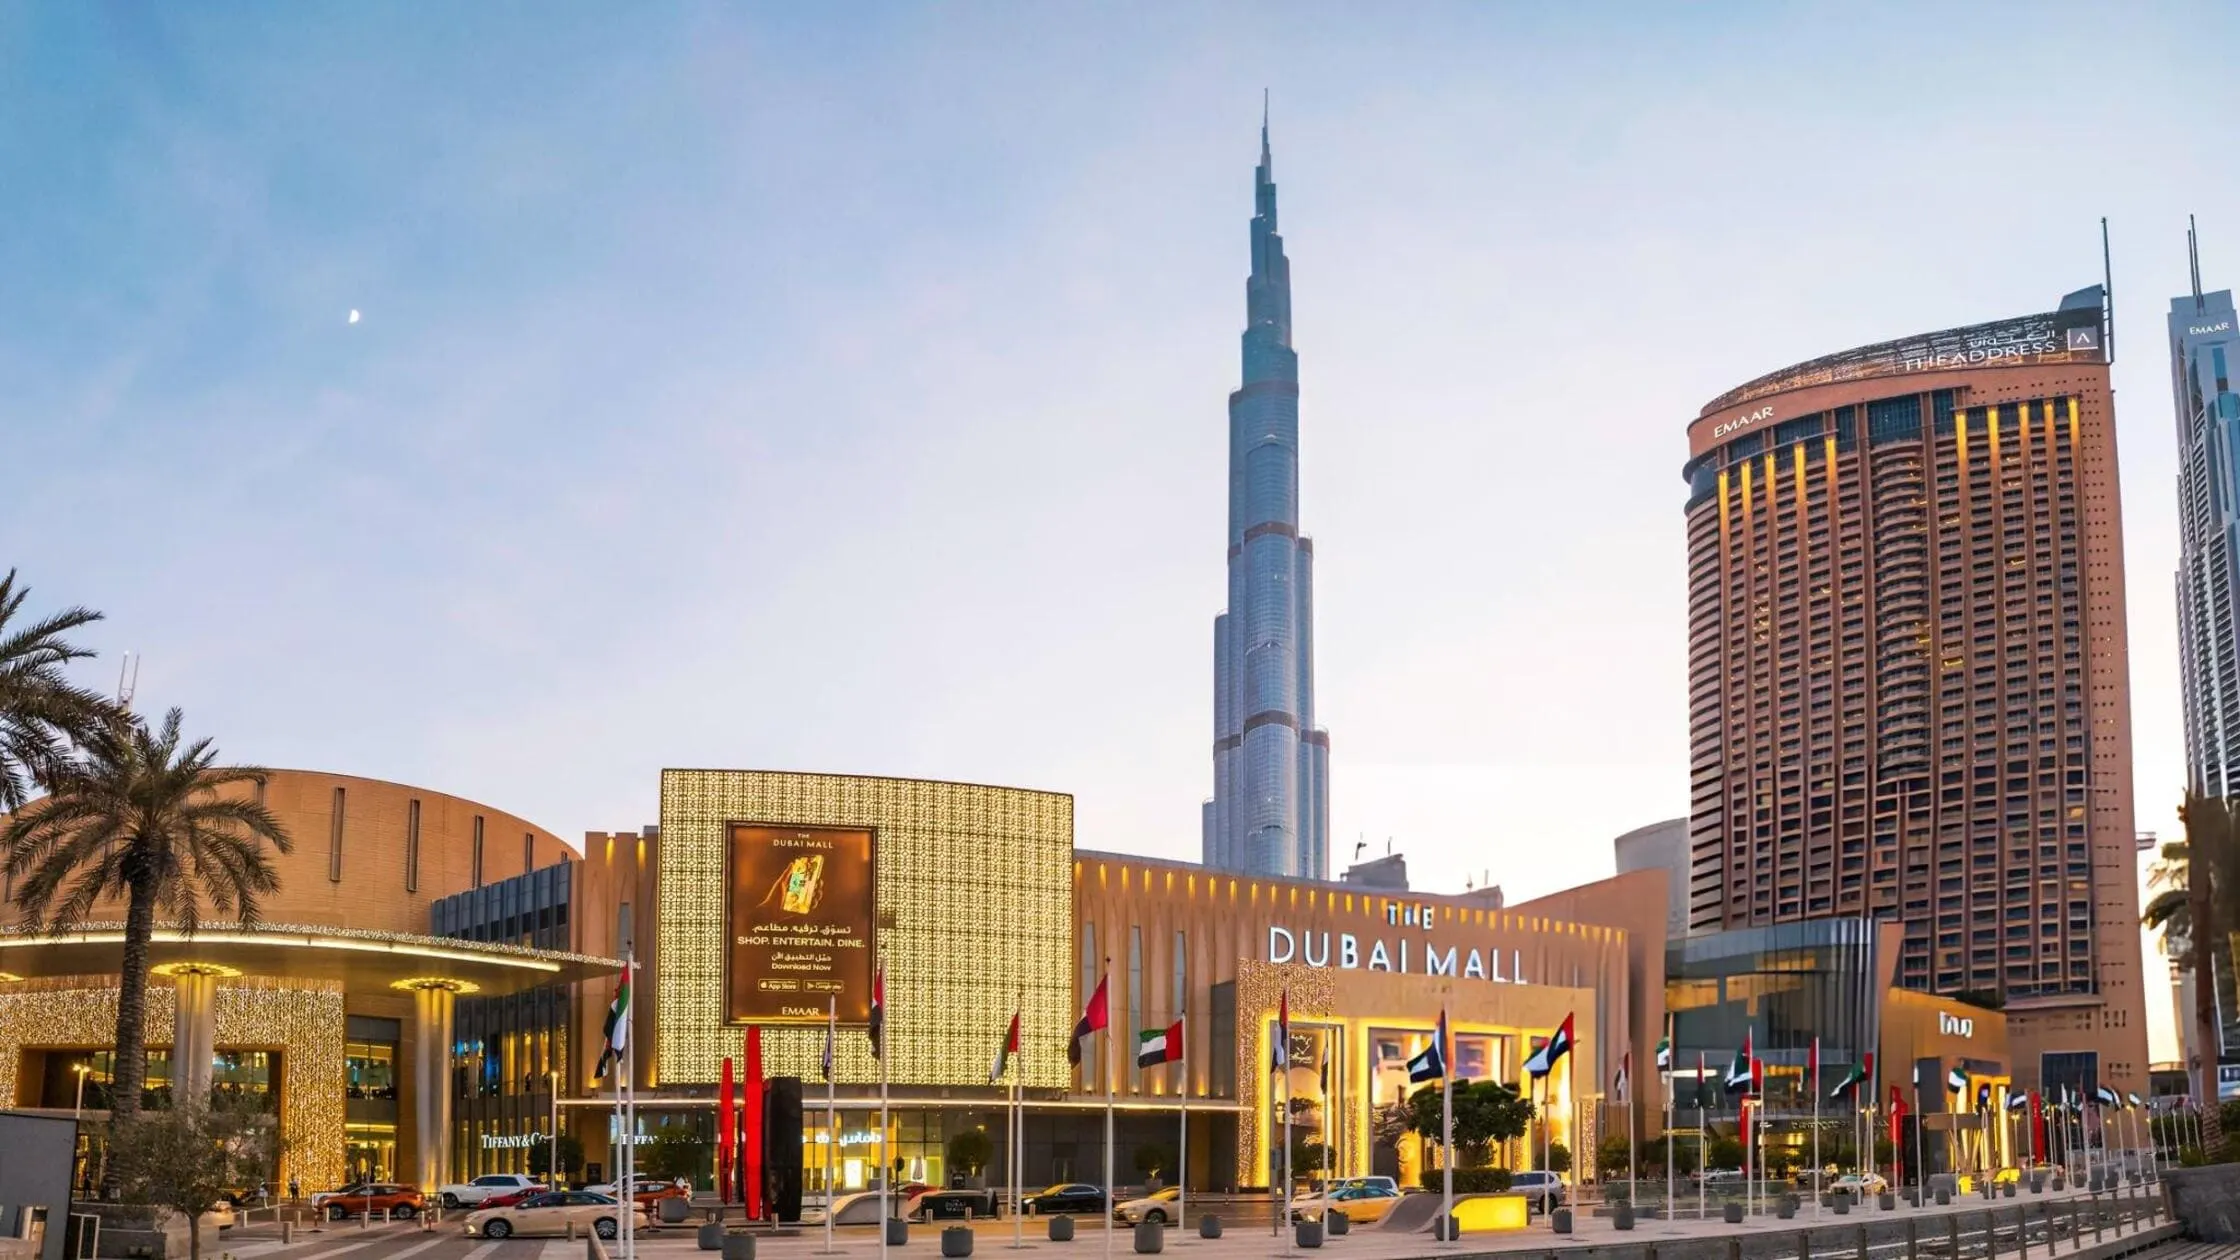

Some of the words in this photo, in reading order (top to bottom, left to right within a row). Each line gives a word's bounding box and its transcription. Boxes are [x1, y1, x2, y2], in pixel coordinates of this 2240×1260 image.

[2189, 322, 2230, 335] EMAAR
[1949, 341, 2056, 365] ADDRESS
[1714, 406, 1775, 438] EMAAR
[773, 839, 804, 847] DUBAI
[806, 840, 834, 849] MALL
[1388, 904, 1434, 930] THE
[737, 936, 770, 945] SHOP.
[772, 937, 835, 947] ENTERTAIN.
[837, 938, 865, 948] DINE.
[1269, 926, 1407, 974] DUBAI
[1427, 943, 1527, 985] MALL
[771, 963, 811, 971] Download
[813, 963, 831, 971] Now
[782, 1007, 820, 1016] EMAAR
